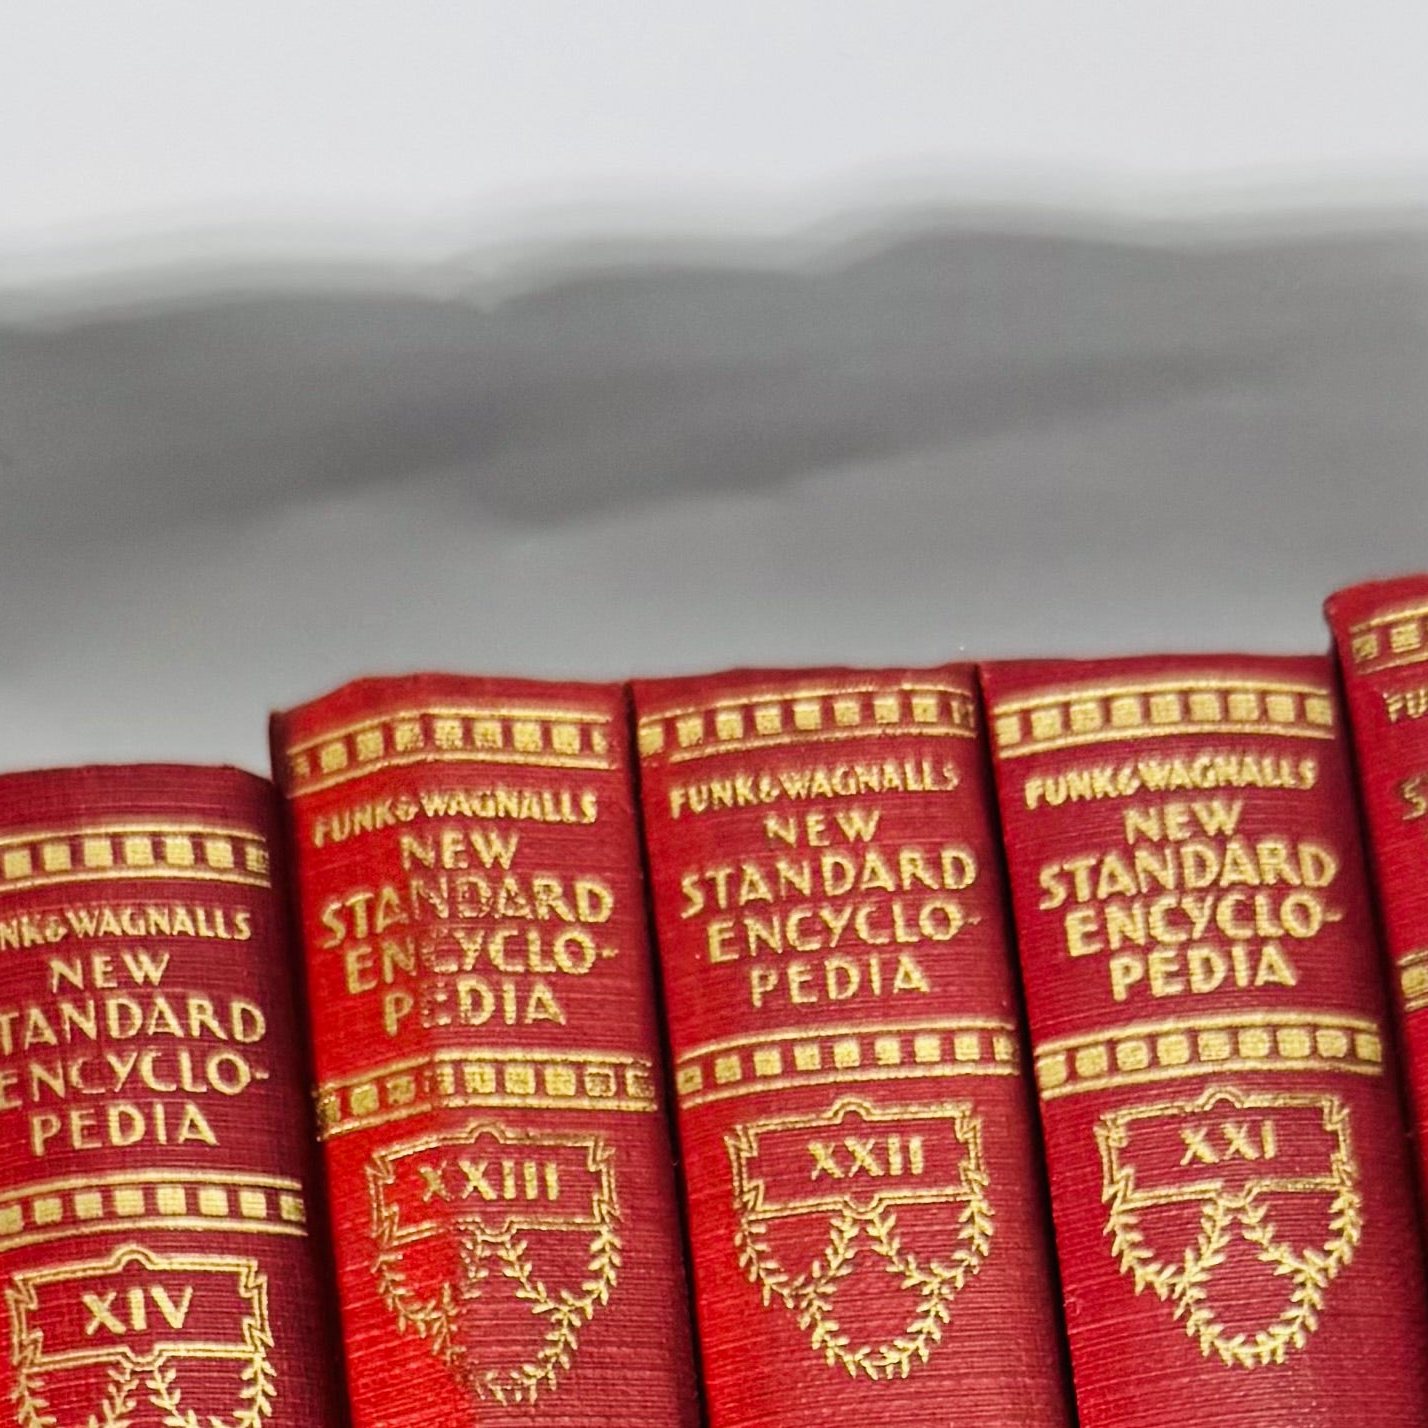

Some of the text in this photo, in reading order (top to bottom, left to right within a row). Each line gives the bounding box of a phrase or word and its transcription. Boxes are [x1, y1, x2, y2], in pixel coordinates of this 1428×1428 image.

[400, 829, 519, 871] NEW
[764, 810, 881, 848] NEW
[1124, 800, 1243, 845] NEW
[680, 848, 977, 919] STANDARD
[1038, 839, 1338, 910] STANDARD
[321, 876, 614, 949] STANDARD
[707, 899, 982, 964] ENCYCLO-
[1065, 893, 1343, 957] ENCYCLO-
[48, 951, 170, 993] NEW
[344, 928, 619, 994] ENCYCLO-
[749, 953, 931, 1008] PEDIA
[1109, 945, 1296, 1003] PEDIA
[382, 976, 566, 1037] PEDIA
[31, 1102, 220, 1157] PEDIA
[808, 1133, 924, 1180] XXII
[1179, 1120, 1278, 1166] XXI
[419, 1160, 560, 1202] XXIII
[81, 1286, 193, 1335] XIV
